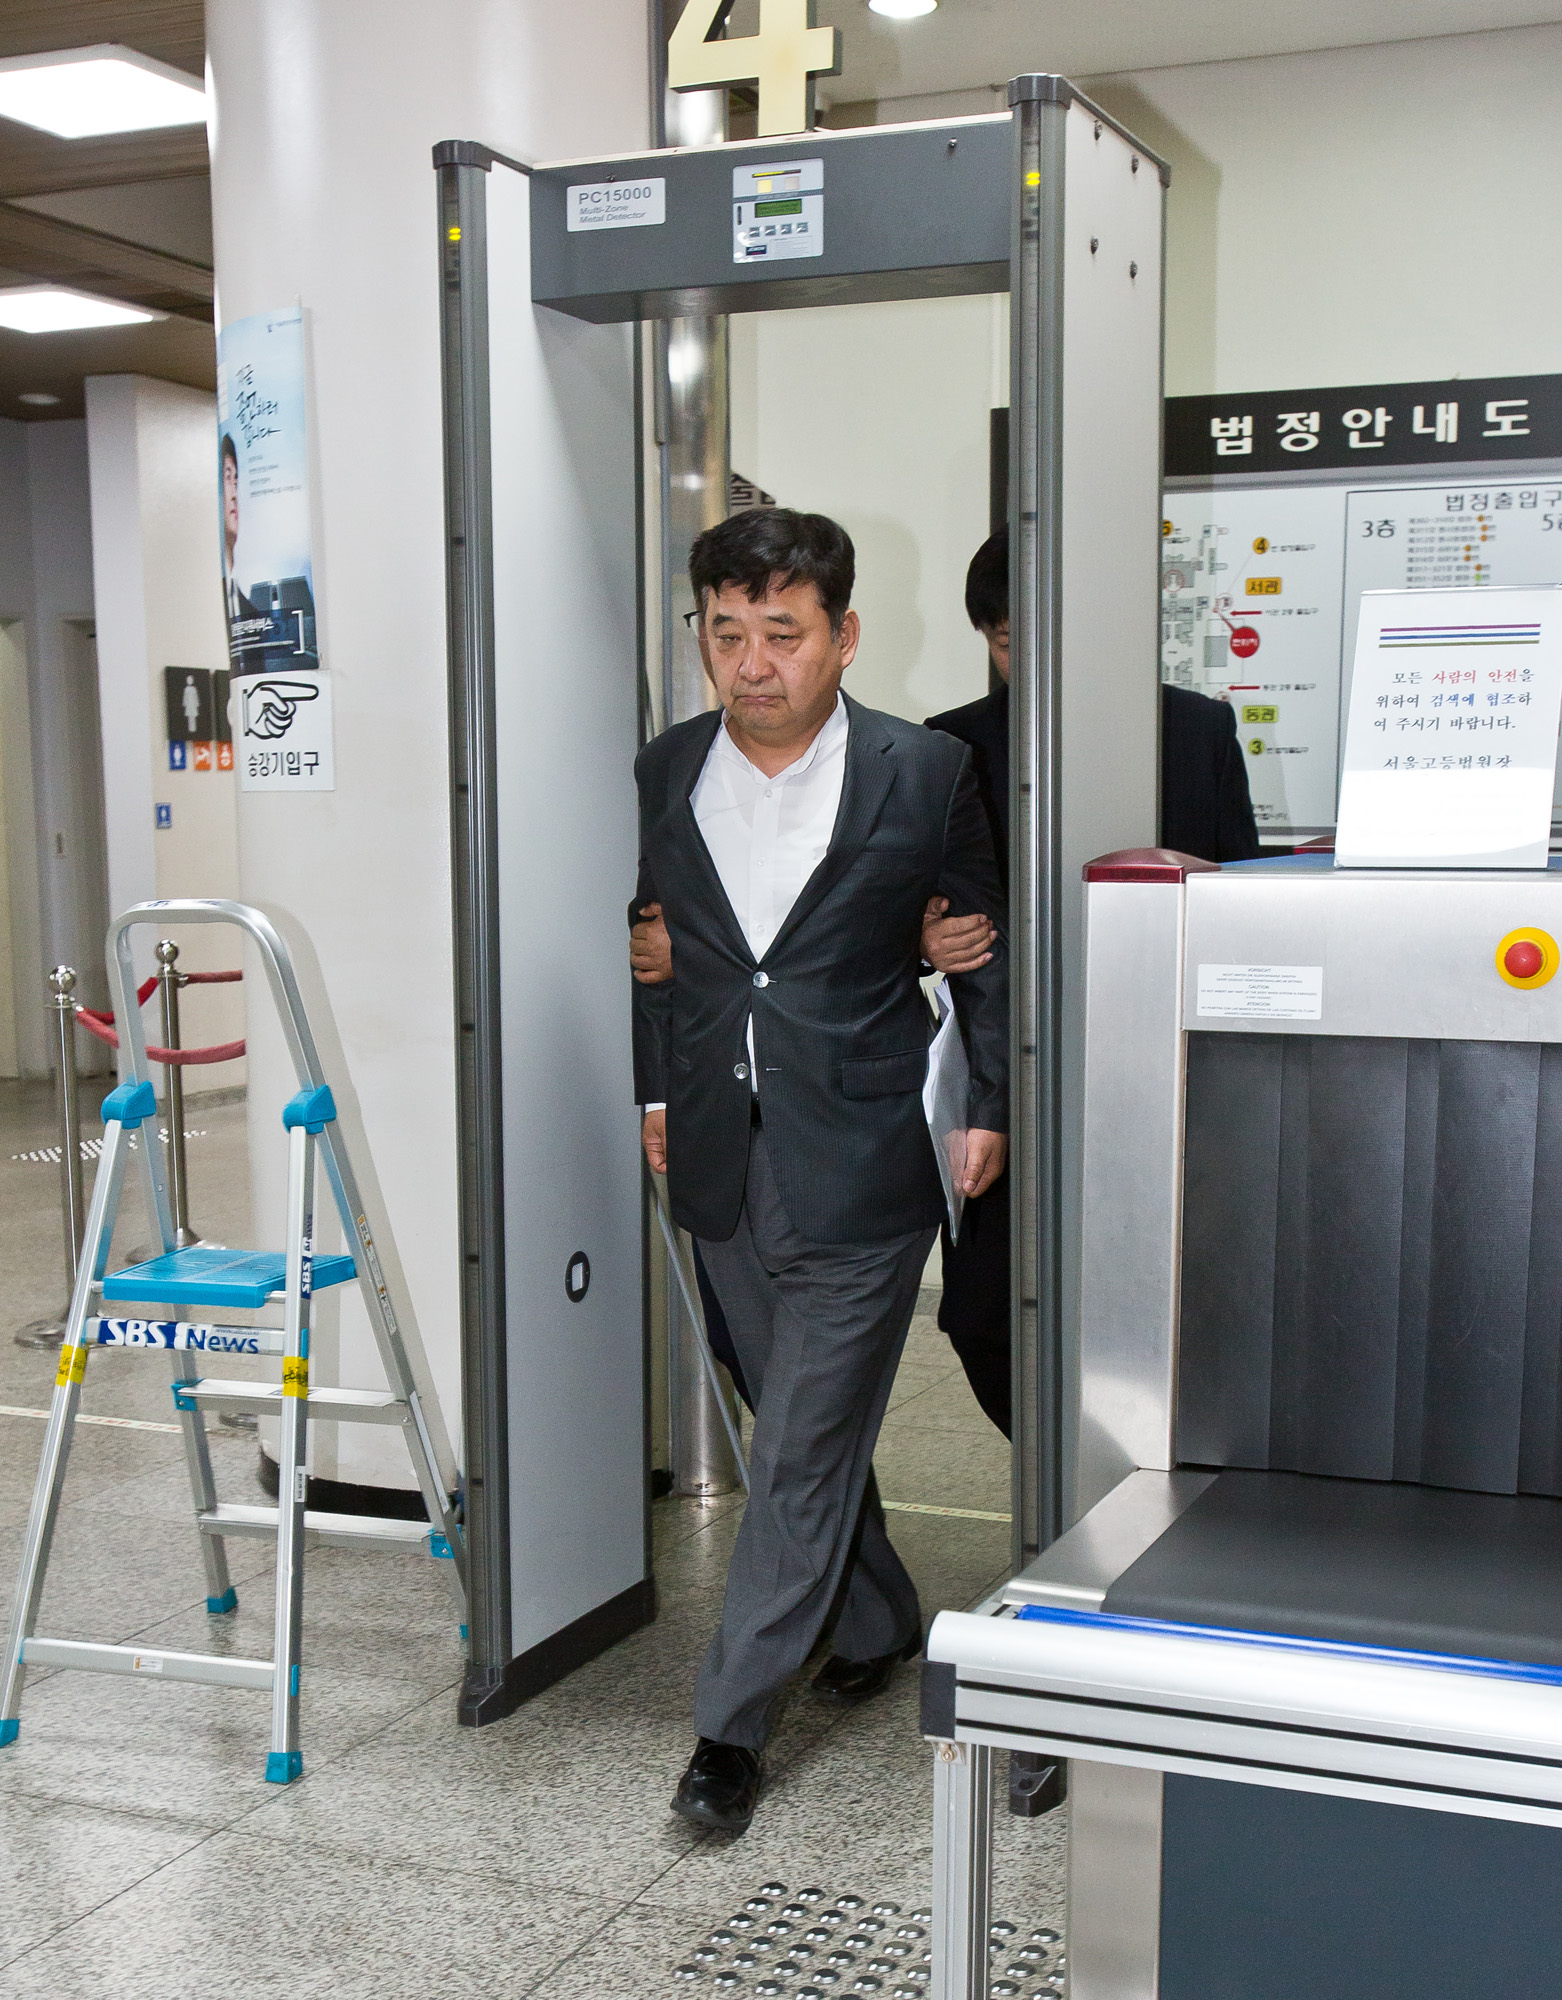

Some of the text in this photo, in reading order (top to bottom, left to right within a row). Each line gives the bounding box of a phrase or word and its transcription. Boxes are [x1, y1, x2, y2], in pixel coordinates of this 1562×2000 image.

[668, 0, 836, 137] 4
[579, 186, 652, 204] PC15000
[579, 205, 629, 215] Multi-Zone
[579, 211, 647, 223] Metal Detector
[1211, 399, 1531, 456] 법정안내도
[1361, 519, 1396, 539] 3층
[1256, 538, 1266, 554] 4
[1392, 668, 1535, 685] 모든 사람의 안전을
[1375, 691, 1533, 708] 위하여 검색에 협조하
[1374, 715, 1517, 732] 여 주시기 바랍니다.
[1251, 741, 1262, 755] 3
[248, 751, 320, 777] 승강기입구
[106, 1318, 168, 1349] SBS
[186, 1328, 259, 1354] News
